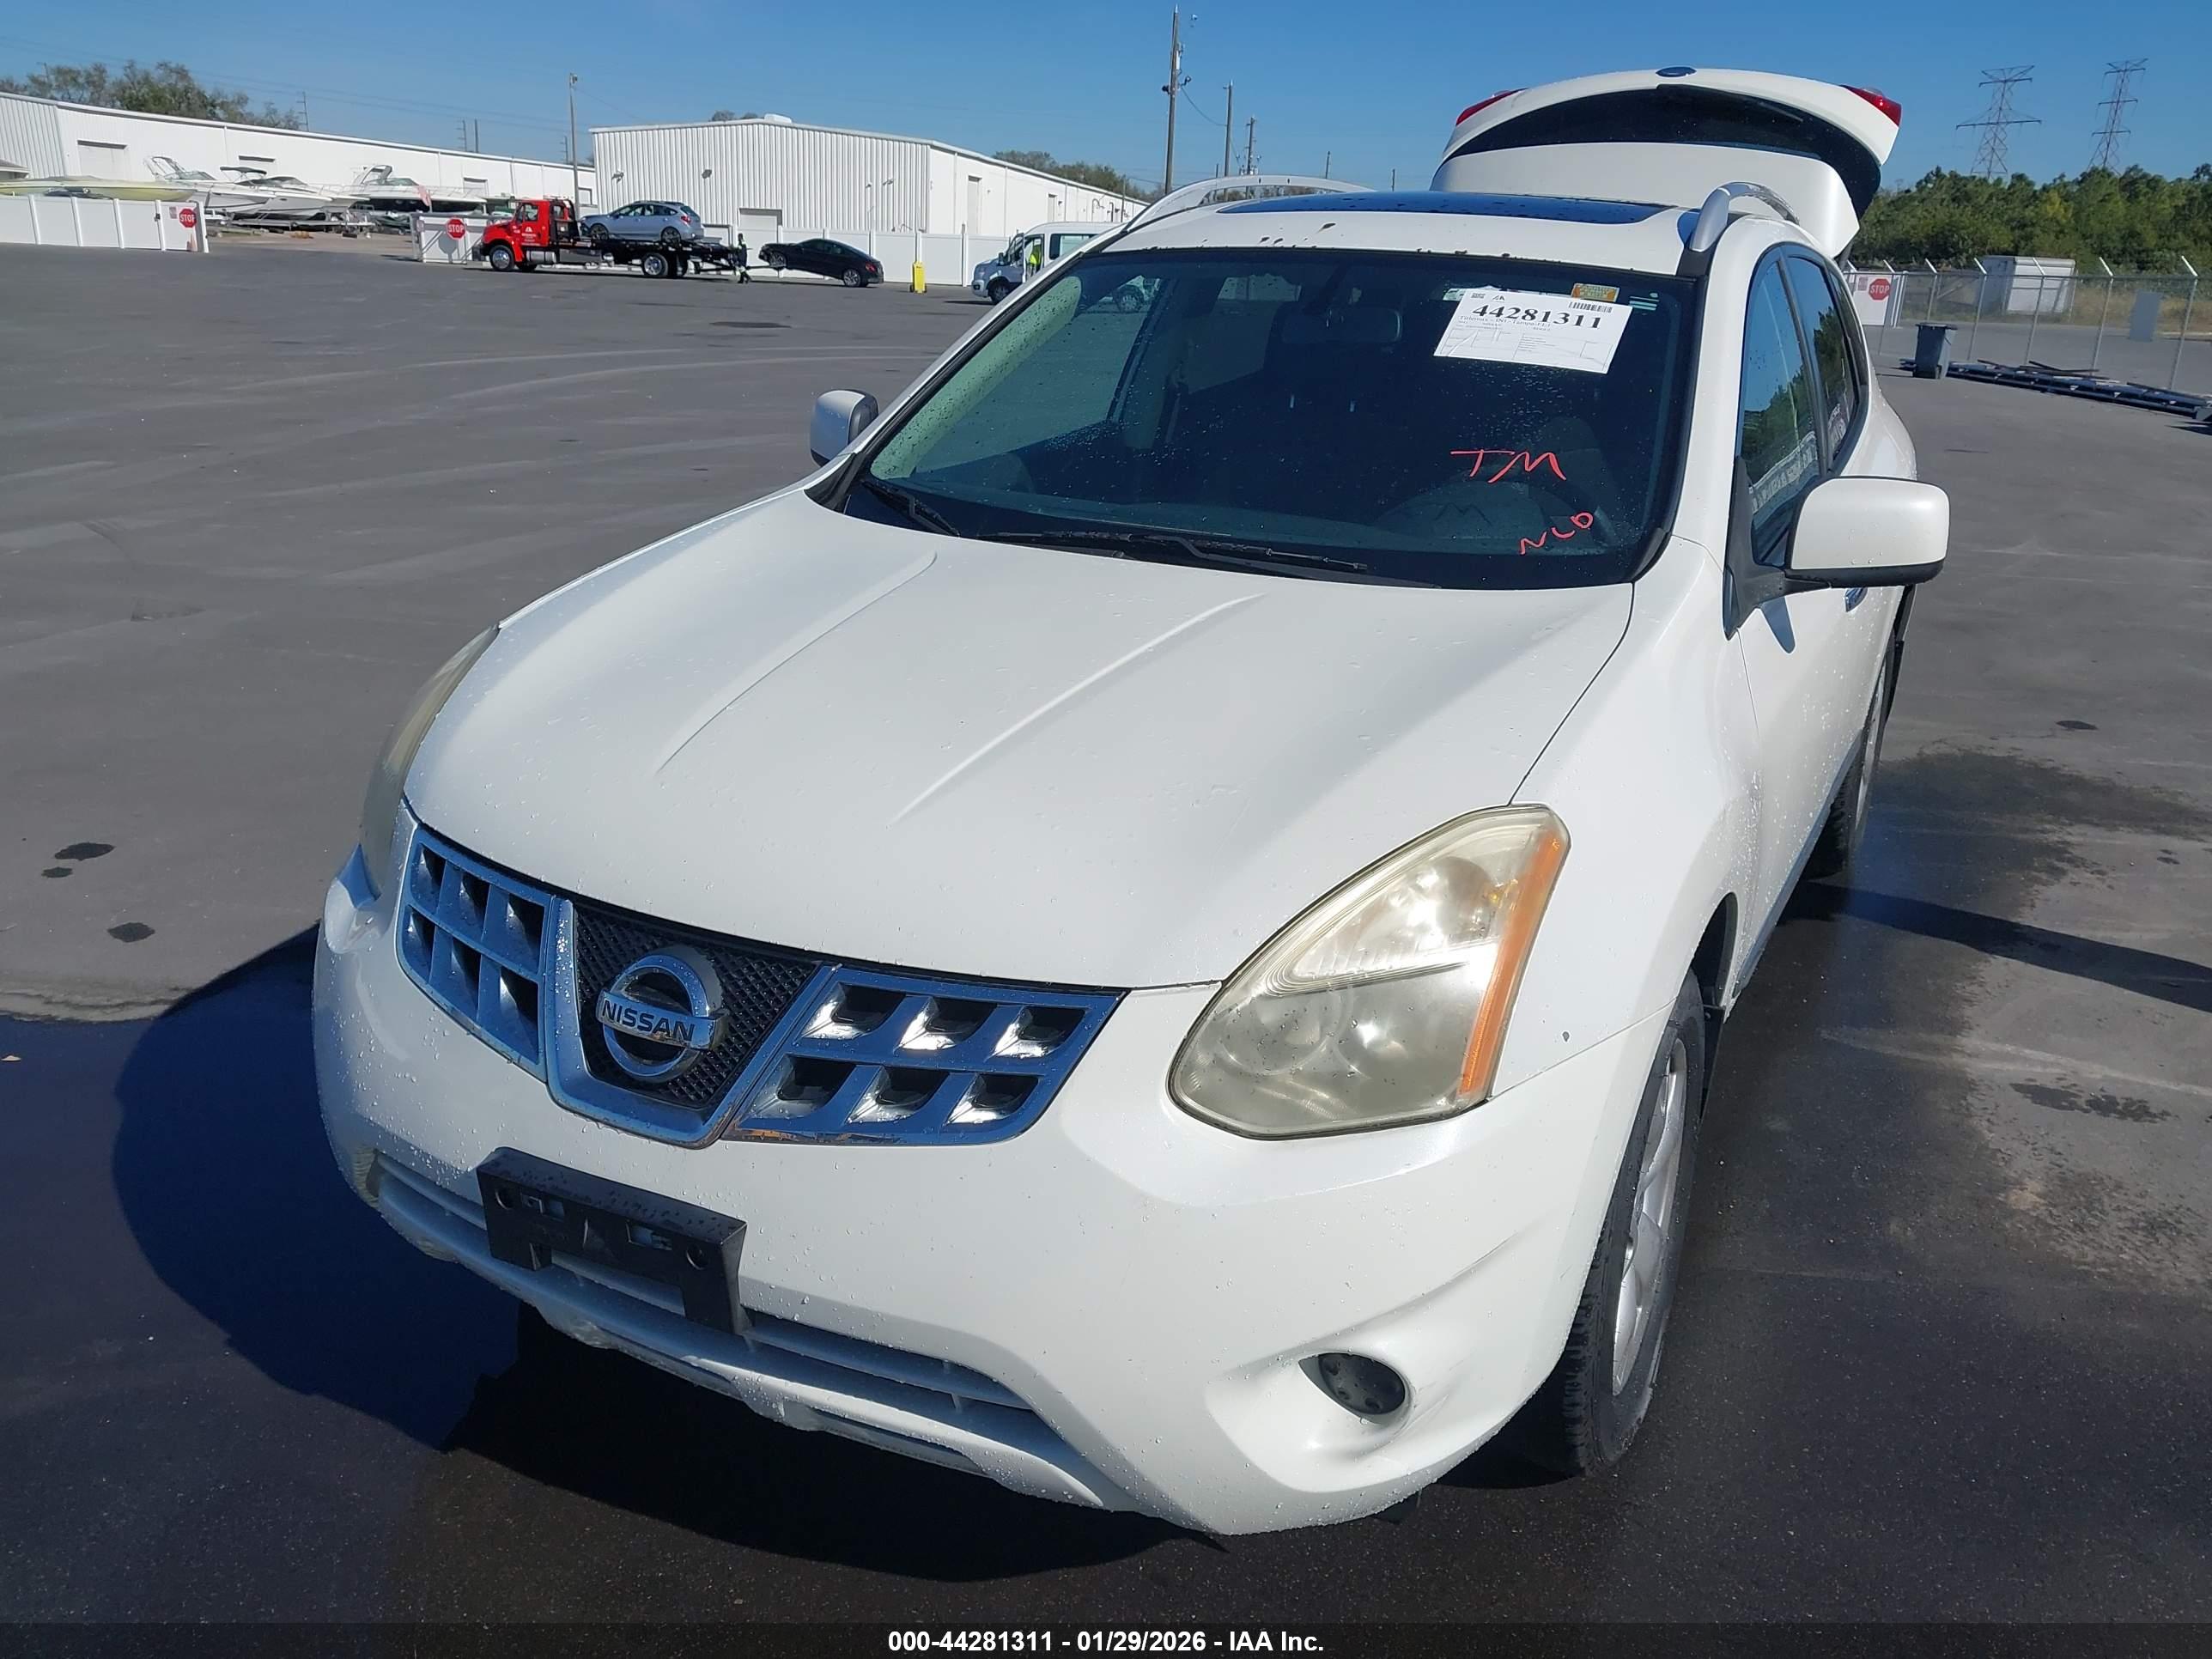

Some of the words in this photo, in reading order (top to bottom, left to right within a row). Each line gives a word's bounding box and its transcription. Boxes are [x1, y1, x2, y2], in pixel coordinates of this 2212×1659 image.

[448, 224, 465, 234] STOP
[1870, 285, 1890, 294] STOP
[1472, 304, 1602, 330] 44281311
[1450, 449, 1567, 483] TM
[602, 1000, 695, 1042] NISSAN
